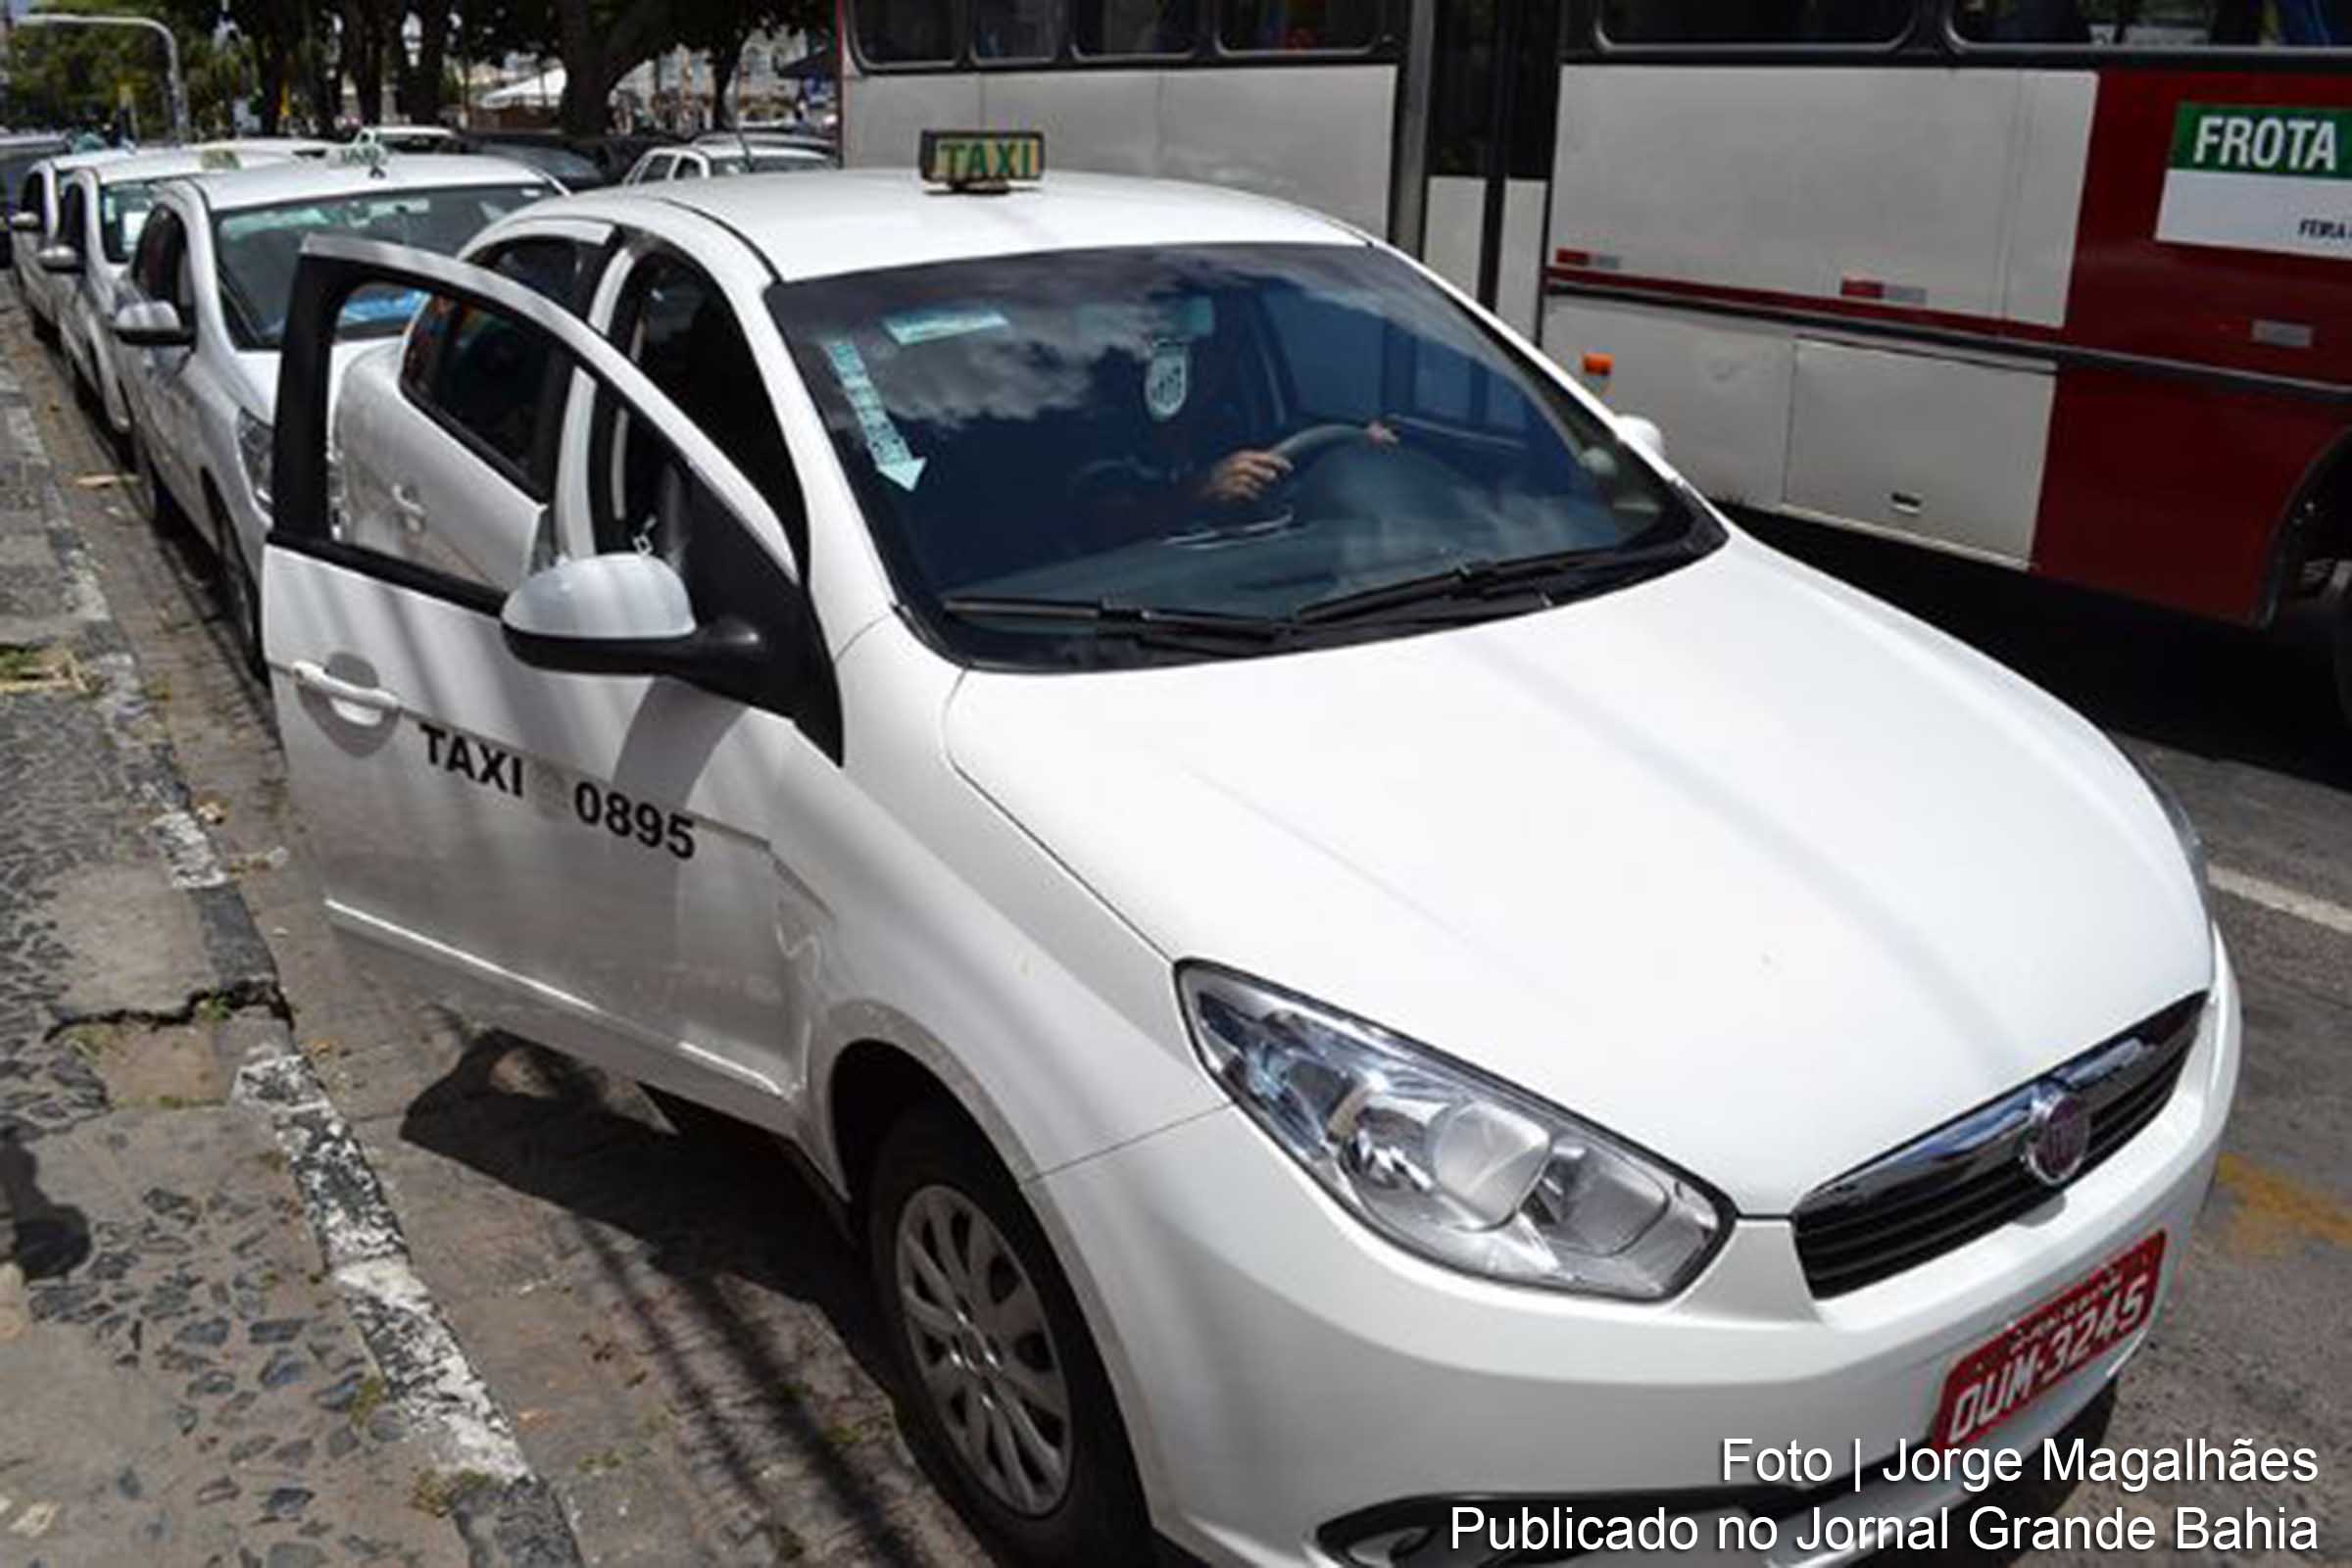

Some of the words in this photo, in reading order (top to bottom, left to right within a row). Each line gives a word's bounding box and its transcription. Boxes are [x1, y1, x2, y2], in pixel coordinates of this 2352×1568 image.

[939, 141, 1030, 176] TAXI
[2193, 116, 2338, 172] FROTA
[419, 722, 522, 798] TAXI
[575, 781, 695, 859] 0895
